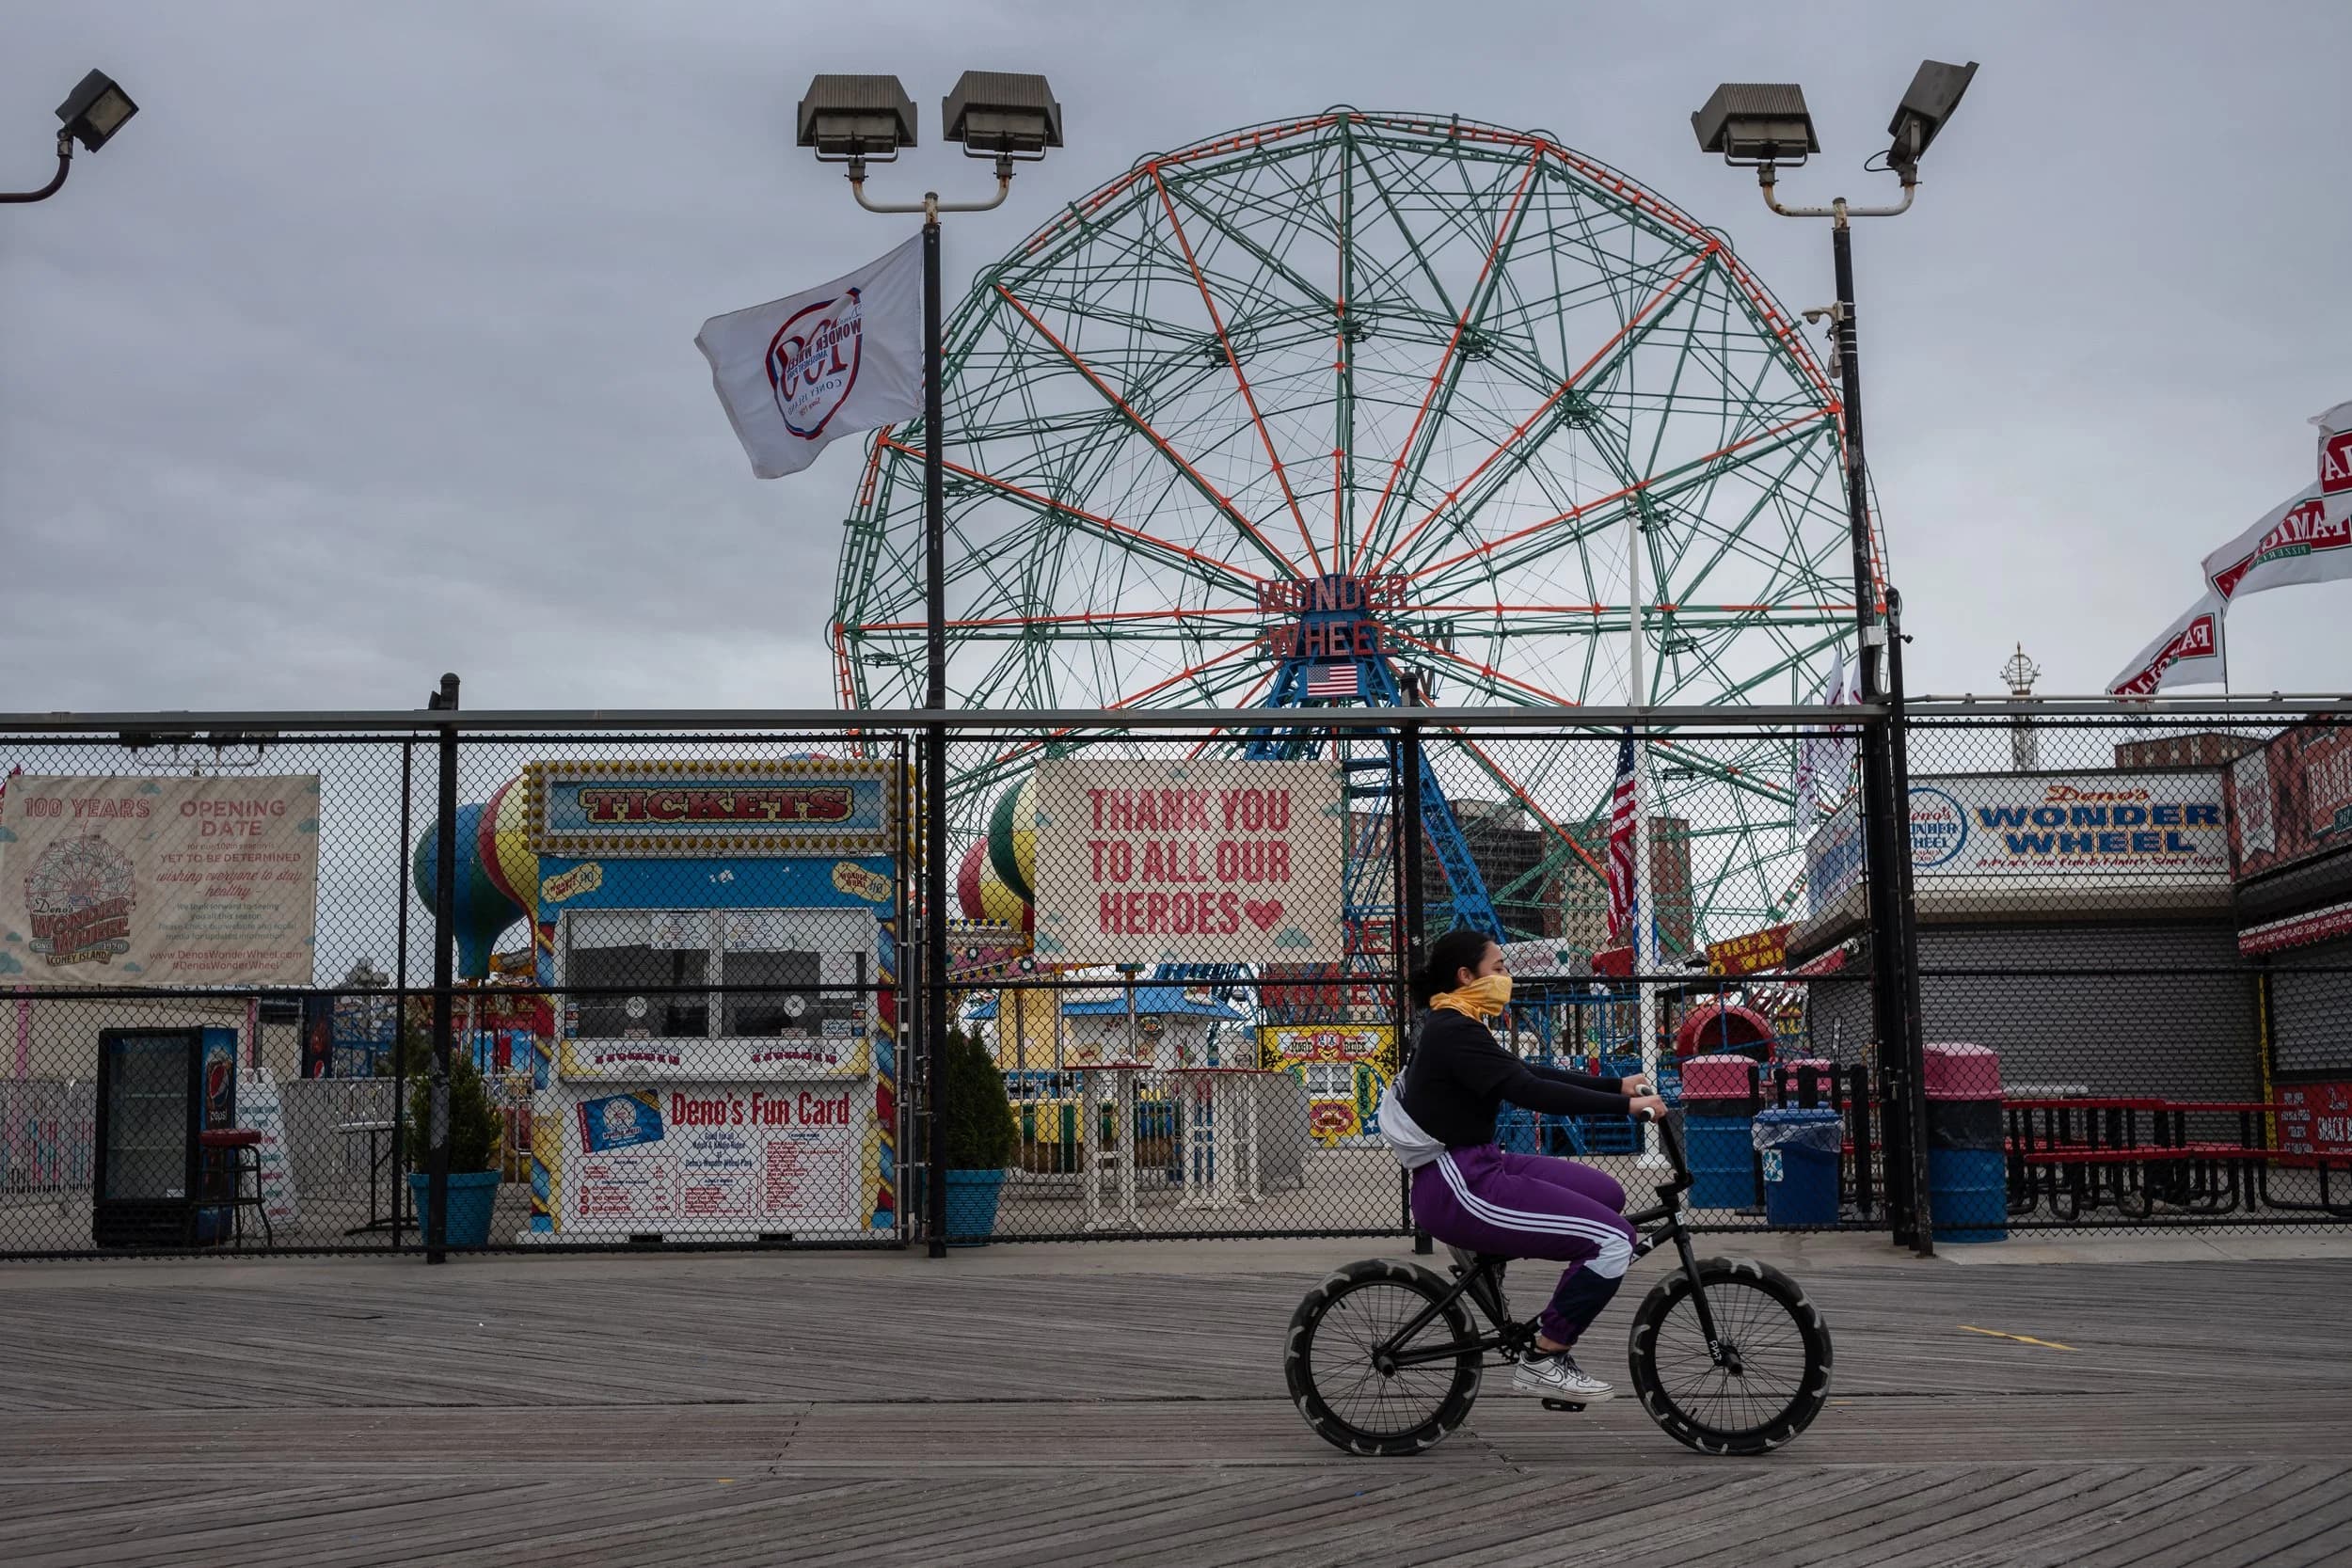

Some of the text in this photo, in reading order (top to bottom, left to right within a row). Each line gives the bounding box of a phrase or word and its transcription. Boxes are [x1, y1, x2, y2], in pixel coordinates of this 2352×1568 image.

[1256, 574, 1407, 611] WONDER
[1267, 620, 1399, 657] WHEEL
[2044, 784, 2149, 801] Deno's
[24, 798, 151, 819] 100 YEARS
[180, 800, 286, 817] OPENING
[584, 790, 850, 820] TICKETS
[1087, 788, 1291, 832] THANK YOU
[1911, 806, 1951, 821] eno's
[1975, 804, 2221, 828] WONDER
[201, 820, 262, 836] DATE
[1912, 823, 1958, 834] NDER
[1913, 837, 1949, 848] HEEL
[2004, 832, 2198, 854] WHEEL
[160, 852, 301, 863] YET TO BE DETERMINED
[1087, 839, 1291, 883] TO ALL OUR
[156, 871, 203, 885] wishing
[205, 871, 259, 884] everyone
[276, 870, 302, 885] stay
[204, 884, 252, 900] healthy
[33, 897, 73, 914] Deno's
[1099, 892, 1239, 935] HEROES
[30, 896, 130, 939] WONDER
[53, 917, 131, 957] WHEEL
[51, 951, 107, 965] CONEY ISLAND
[150, 950, 302, 960] www.DenosWonderWheel.com
[172, 960, 281, 971] #DenosWonderWheel
[671, 1092, 850, 1126] Deno's Fun Card
